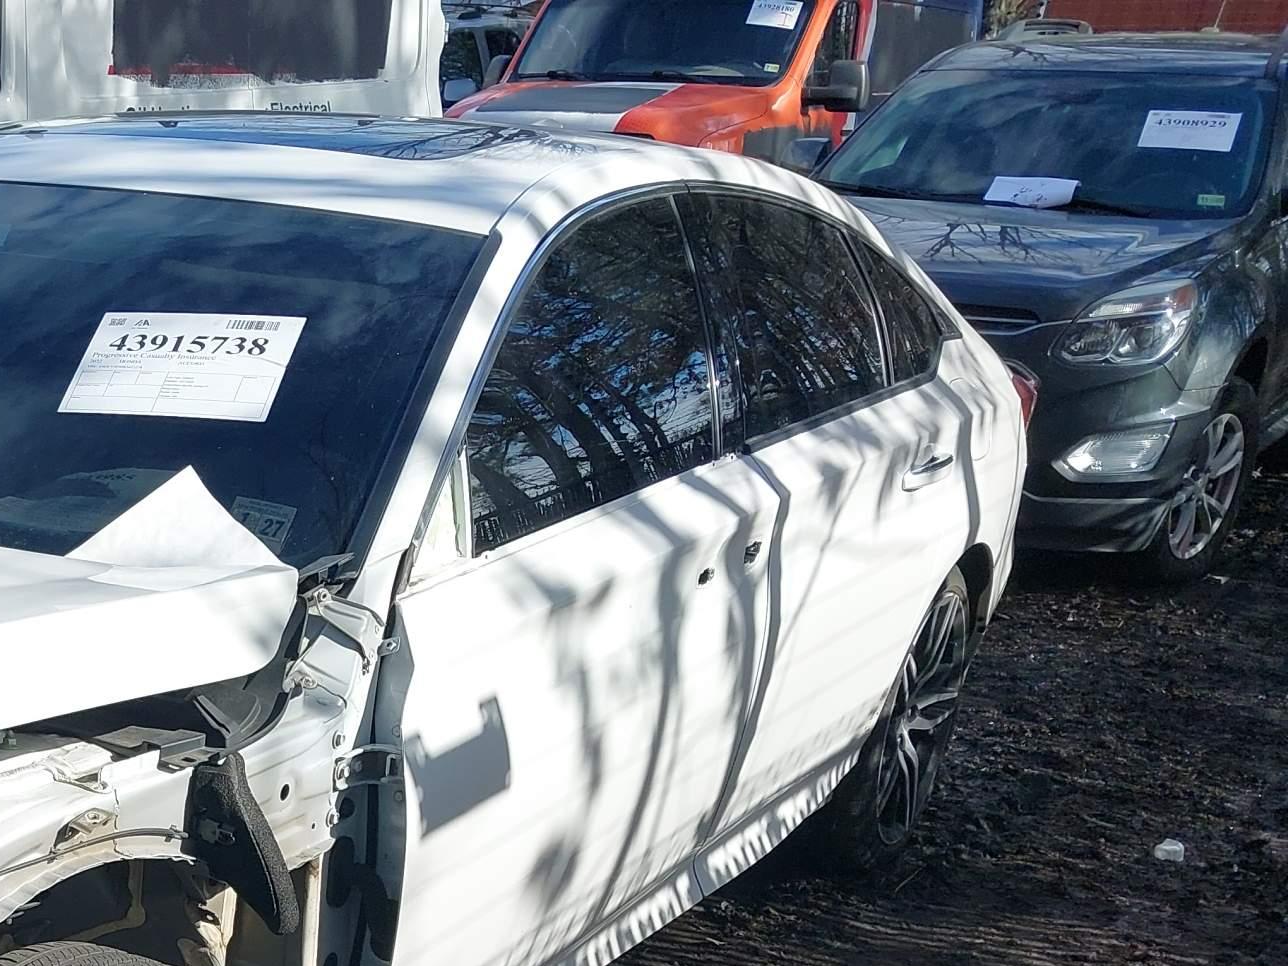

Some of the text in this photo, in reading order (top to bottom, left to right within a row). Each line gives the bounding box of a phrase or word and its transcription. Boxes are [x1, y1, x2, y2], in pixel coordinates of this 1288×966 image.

[1155, 118, 1227, 128] 43908929
[109, 333, 269, 356] 43915738
[92, 352, 217, 361] Progressive Casualty Insurance
[258, 518, 286, 538] 27
